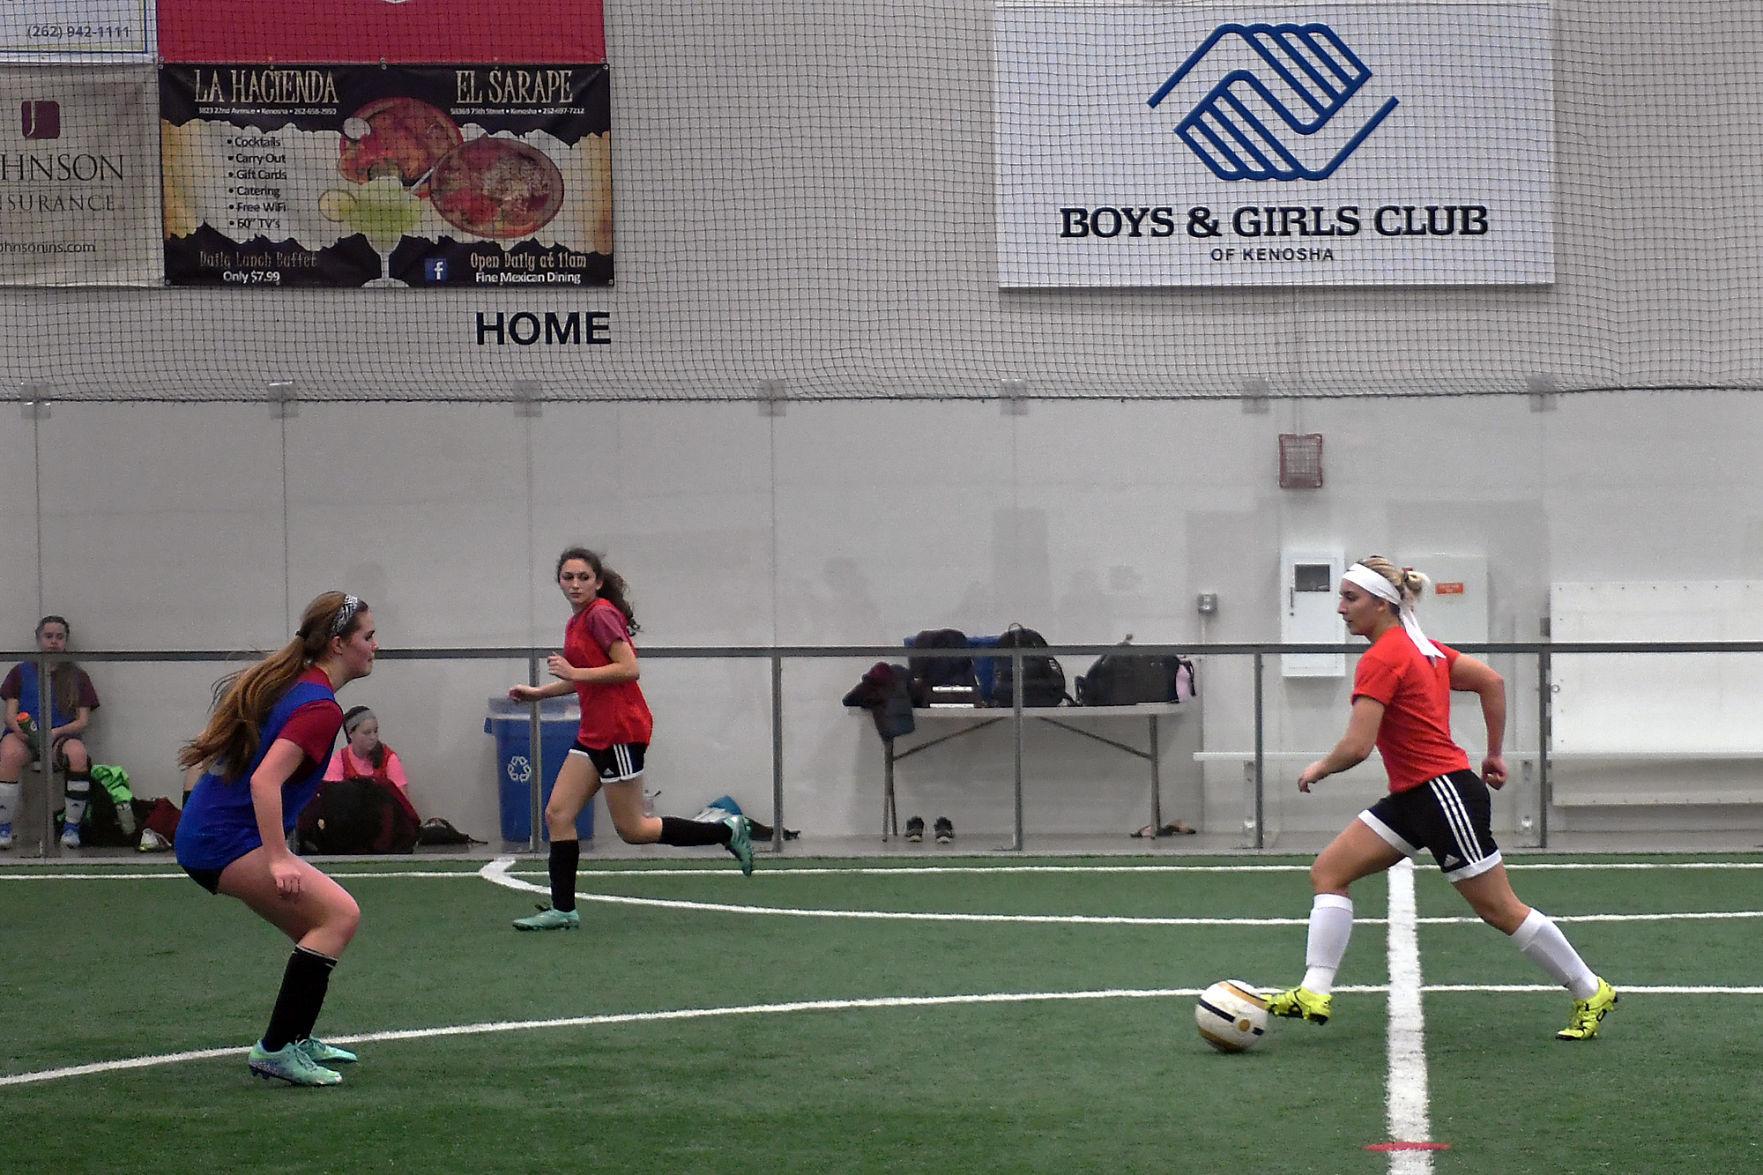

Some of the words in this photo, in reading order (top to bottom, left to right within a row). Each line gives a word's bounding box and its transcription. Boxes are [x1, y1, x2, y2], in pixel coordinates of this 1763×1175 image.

[27, 25, 62, 39] (262)
[67, 25, 129, 38] 942-1111
[195, 69, 225, 103] LA
[231, 70, 339, 103] HACIENDA
[456, 70, 483, 104] EL
[488, 70, 573, 103] SARAPE
[510, 107, 537, 115] Kenosha
[235, 137, 281, 147] Cocktails
[236, 154, 264, 165] Carry
[265, 154, 286, 164] Out
[236, 169, 255, 179] Gift
[258, 170, 287, 180] Cards
[236, 186, 280, 197] Catering
[0, 194, 115, 212] SURANCE
[236, 203, 260, 212] Free
[263, 202, 286, 212] WiFi
[1060, 206, 1174, 239] BOYS
[1186, 206, 1223, 238] &
[1232, 205, 1360, 238] GIRLS
[1374, 204, 1489, 236] CLUB
[199, 251, 231, 269] Daily
[236, 252, 271, 267] Lunch
[276, 251, 318, 267] Buffet
[470, 253, 500, 270] Open
[504, 252, 535, 270] Daily
[540, 253, 554, 267] at
[558, 252, 587, 267] 11am
[1210, 248, 1235, 261] OF
[1242, 247, 1334, 261] KENOSHA
[223, 271, 248, 284] Only
[251, 270, 280, 283] $7.99
[475, 272, 498, 283] Fine
[500, 272, 544, 283] Mexican
[547, 272, 581, 284] Dining
[476, 311, 611, 345] HOME
